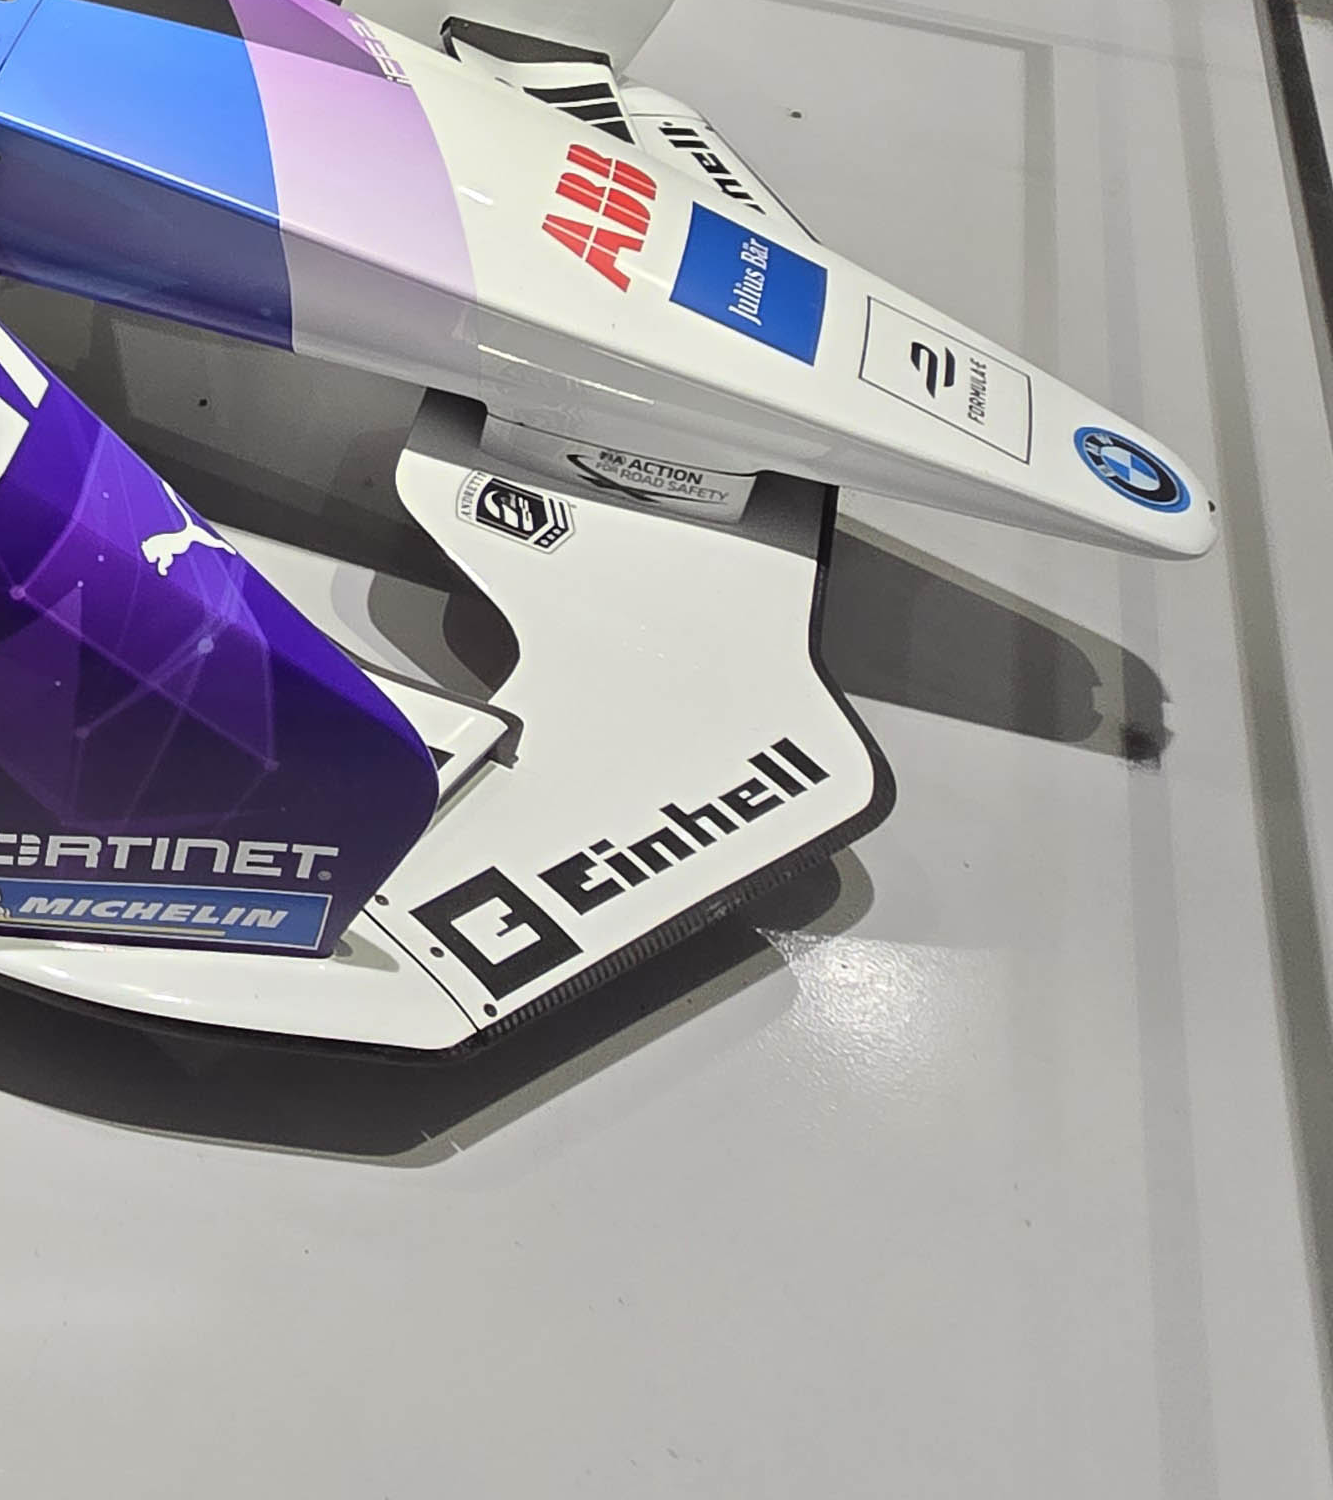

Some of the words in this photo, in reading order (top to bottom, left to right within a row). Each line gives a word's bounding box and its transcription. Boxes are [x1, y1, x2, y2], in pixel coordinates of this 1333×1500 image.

[541, 143, 658, 293] ABB
[739, 237, 769, 271] Bär
[728, 268, 763, 327] Julius
[620, 469, 665, 489] ROAD
[667, 479, 730, 502] SAFETY
[629, 458, 704, 486] ACTION
[536, 737, 831, 917] Einhell
[19, 893, 289, 933] MICHELIN
